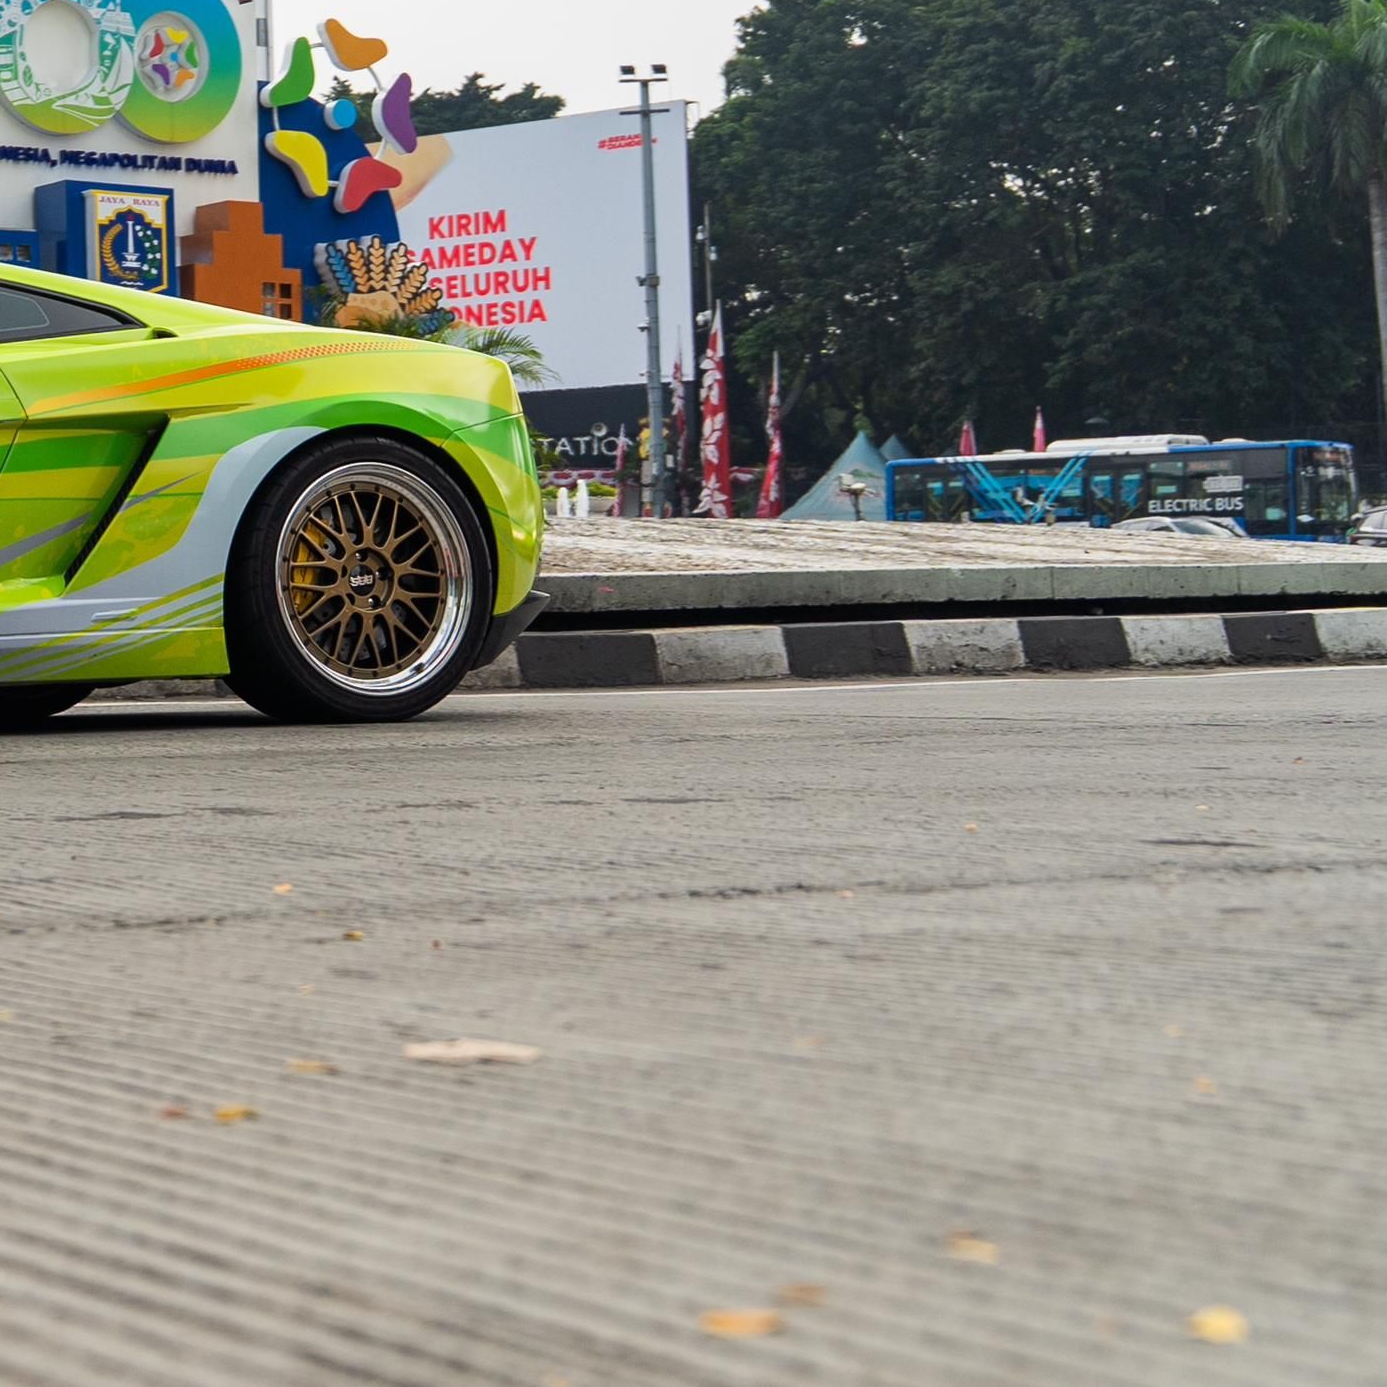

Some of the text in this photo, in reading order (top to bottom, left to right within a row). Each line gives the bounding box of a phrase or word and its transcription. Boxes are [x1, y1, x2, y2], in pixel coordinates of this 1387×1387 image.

[99, 196, 161, 207] JAYA RAYA
[428, 209, 508, 240] KIRIM
[530, 435, 634, 456] TATIO
[1148, 496, 1244, 513] ELECTRIC BUS
